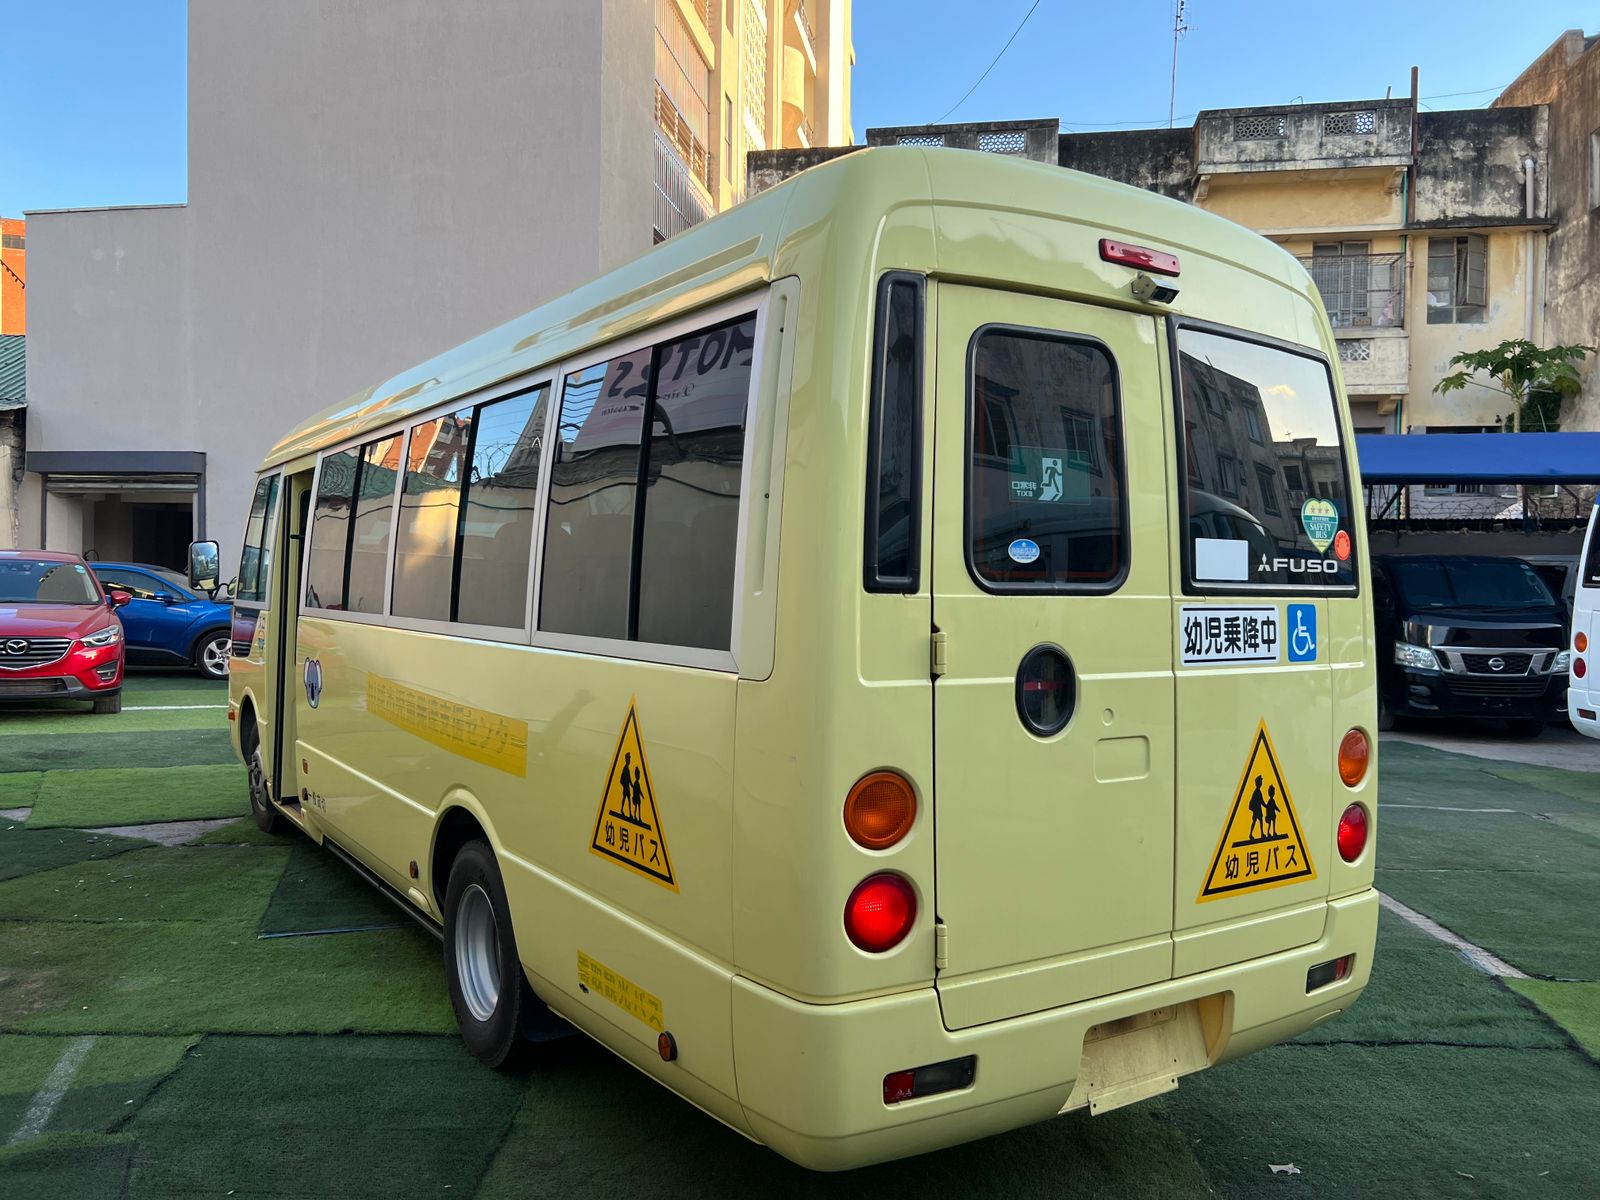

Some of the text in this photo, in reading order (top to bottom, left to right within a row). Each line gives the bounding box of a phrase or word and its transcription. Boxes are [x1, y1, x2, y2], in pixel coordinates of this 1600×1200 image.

[1309, 523, 1332, 531] SAFETY
[1315, 531, 1328, 539] BUS
[1273, 558, 1338, 573] FUSO
[1184, 615, 1277, 656] 幼児乗降中
[604, 820, 661, 867] 幼児バス
[1224, 844, 1298, 880] 幼児バス
